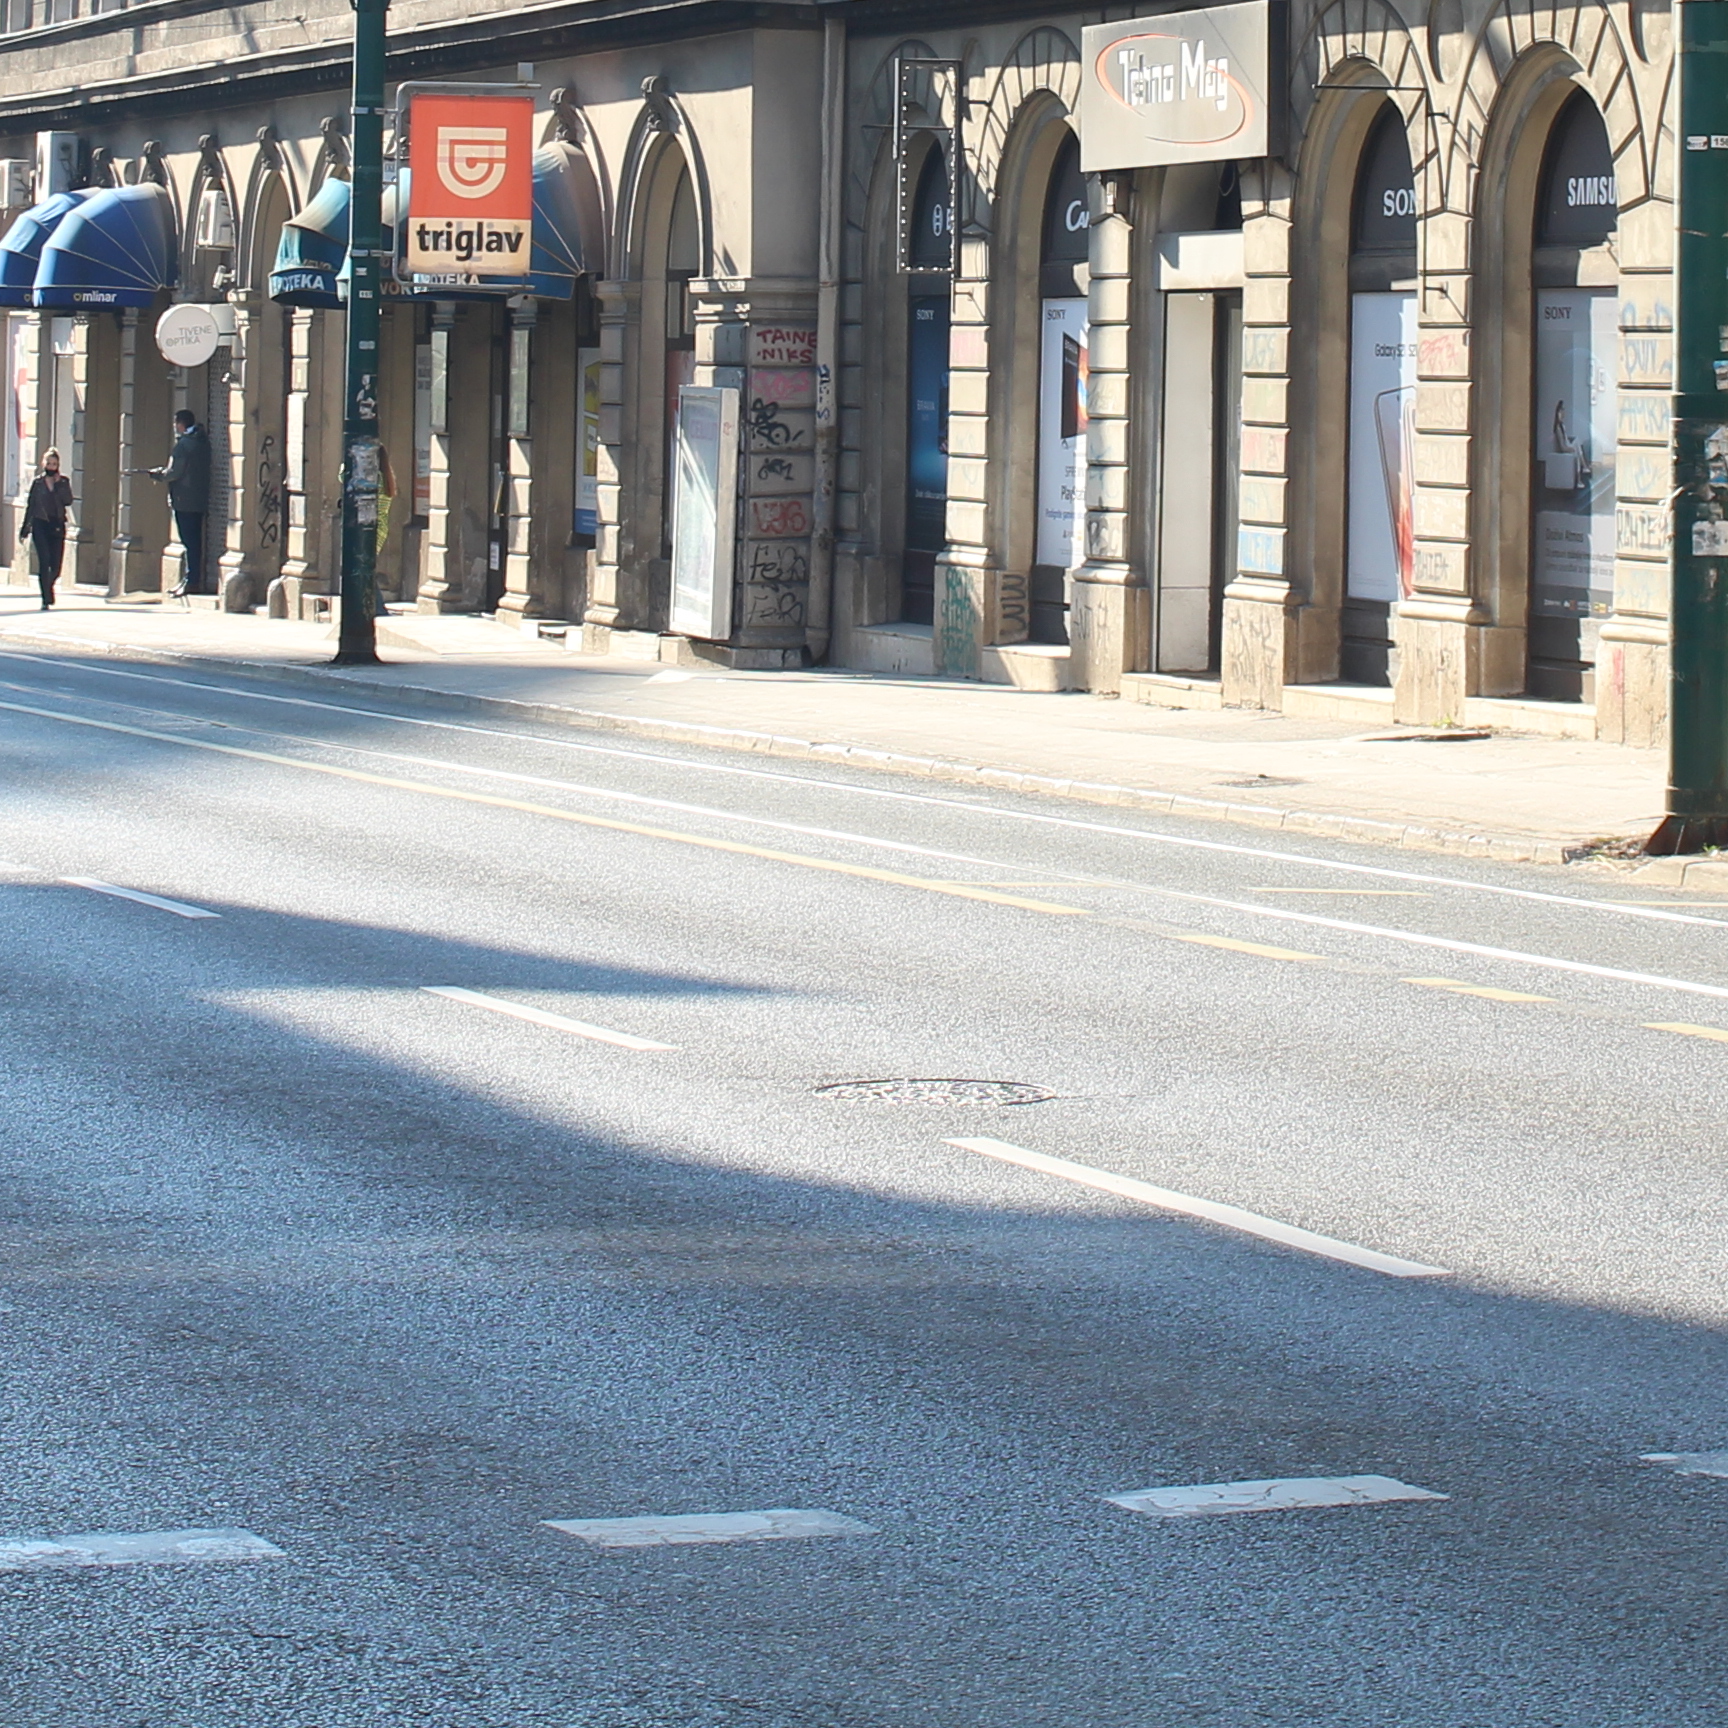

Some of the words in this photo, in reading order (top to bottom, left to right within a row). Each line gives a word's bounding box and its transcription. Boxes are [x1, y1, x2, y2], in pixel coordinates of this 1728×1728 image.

[416, 220, 524, 262] triglav
[82, 290, 117, 303] mlinar
[917, 309, 935, 321] SONY
[1046, 309, 1066, 321] SONY
[1544, 306, 1571, 319] SONY
[178, 325, 212, 336] TIVENE
[165, 335, 200, 348] OPTIKA
